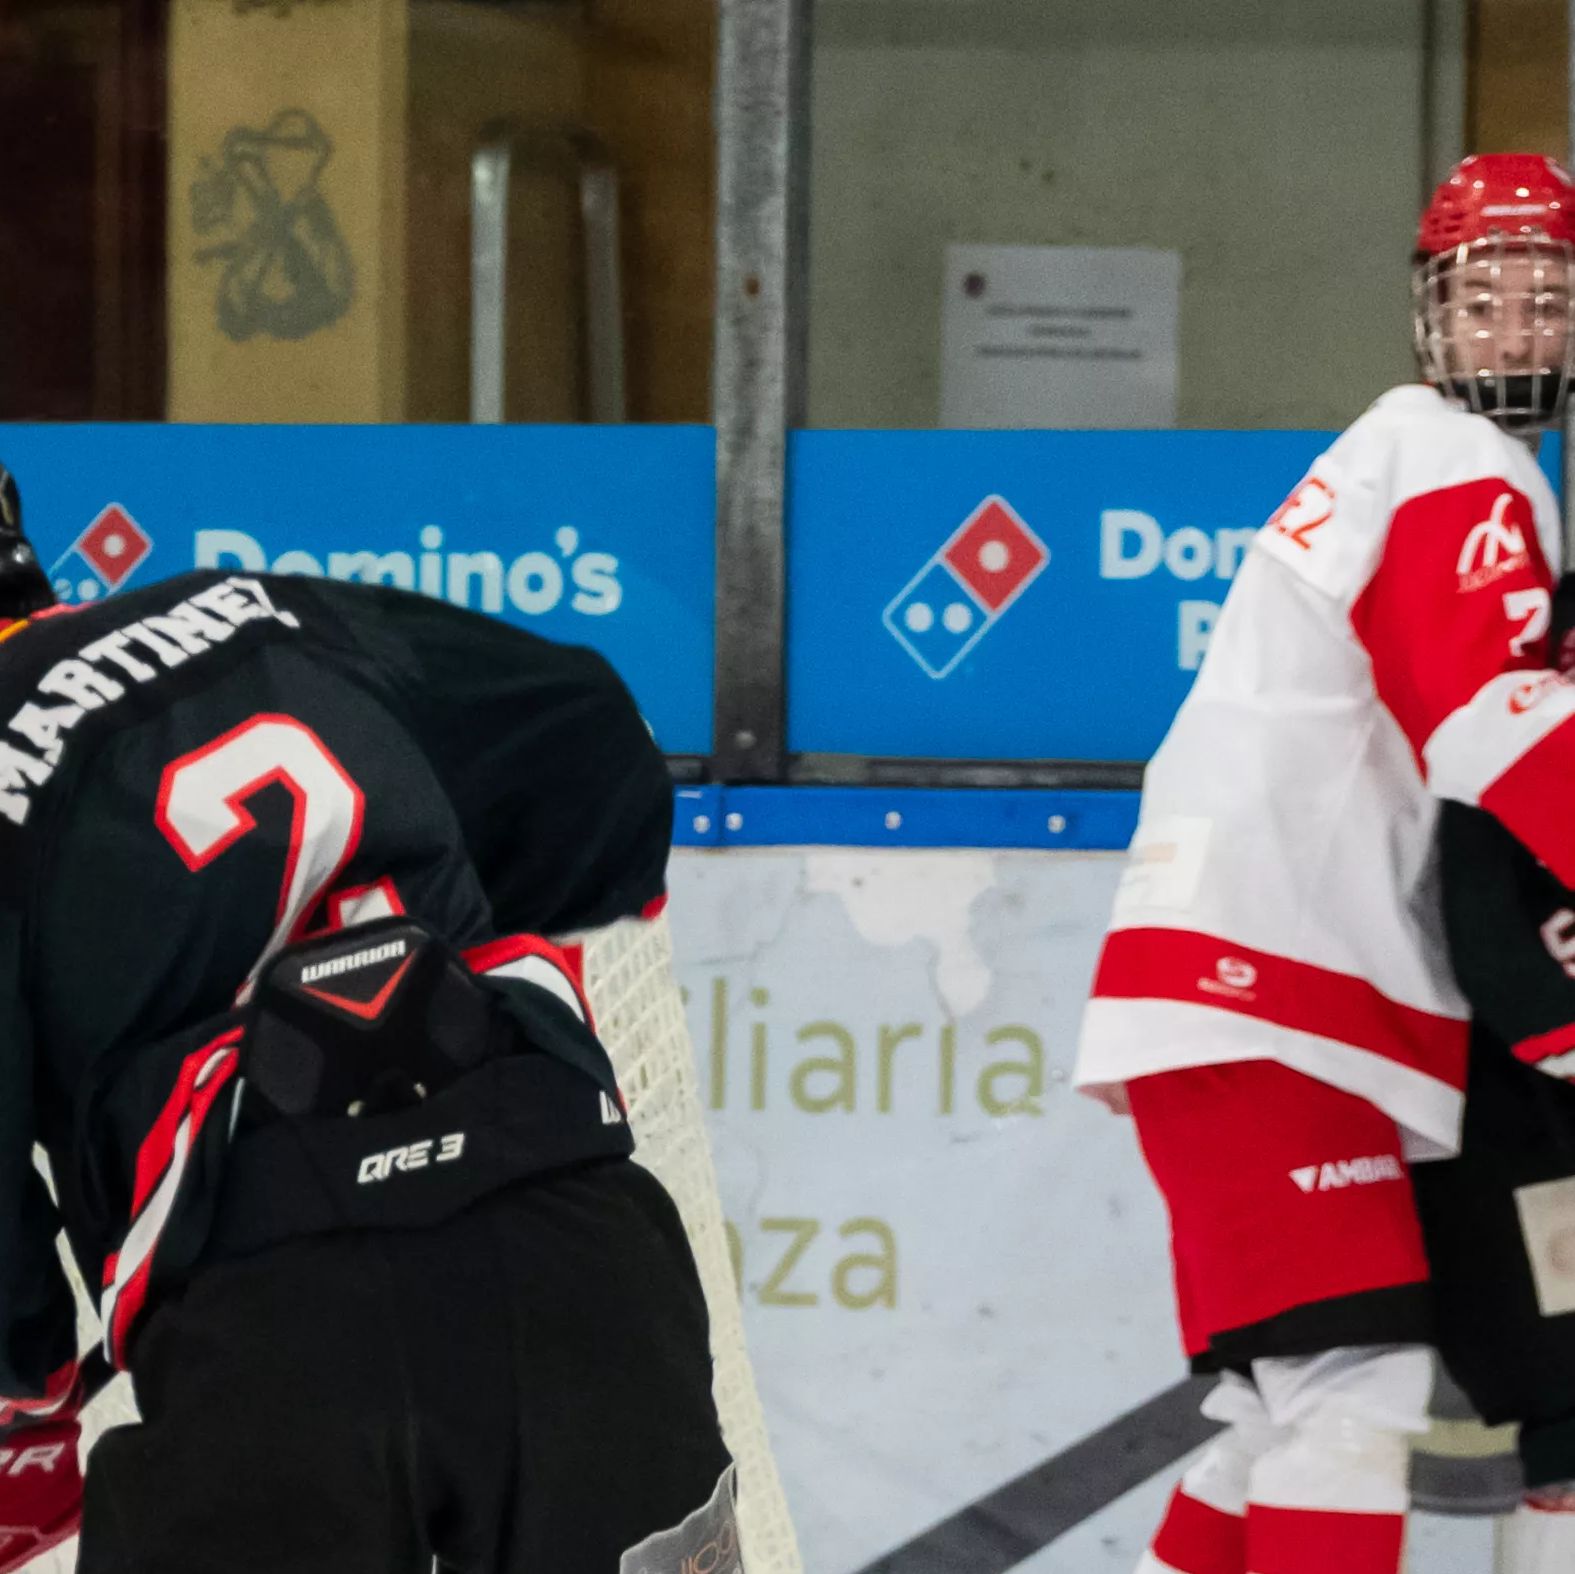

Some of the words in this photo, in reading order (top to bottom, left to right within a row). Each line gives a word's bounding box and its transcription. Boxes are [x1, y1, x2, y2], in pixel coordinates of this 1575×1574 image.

[301, 940, 406, 984] WARRIOR
[708, 976, 1046, 1118] liaria
[356, 1139, 433, 1185] QRE
[435, 1132, 466, 1162] 3
